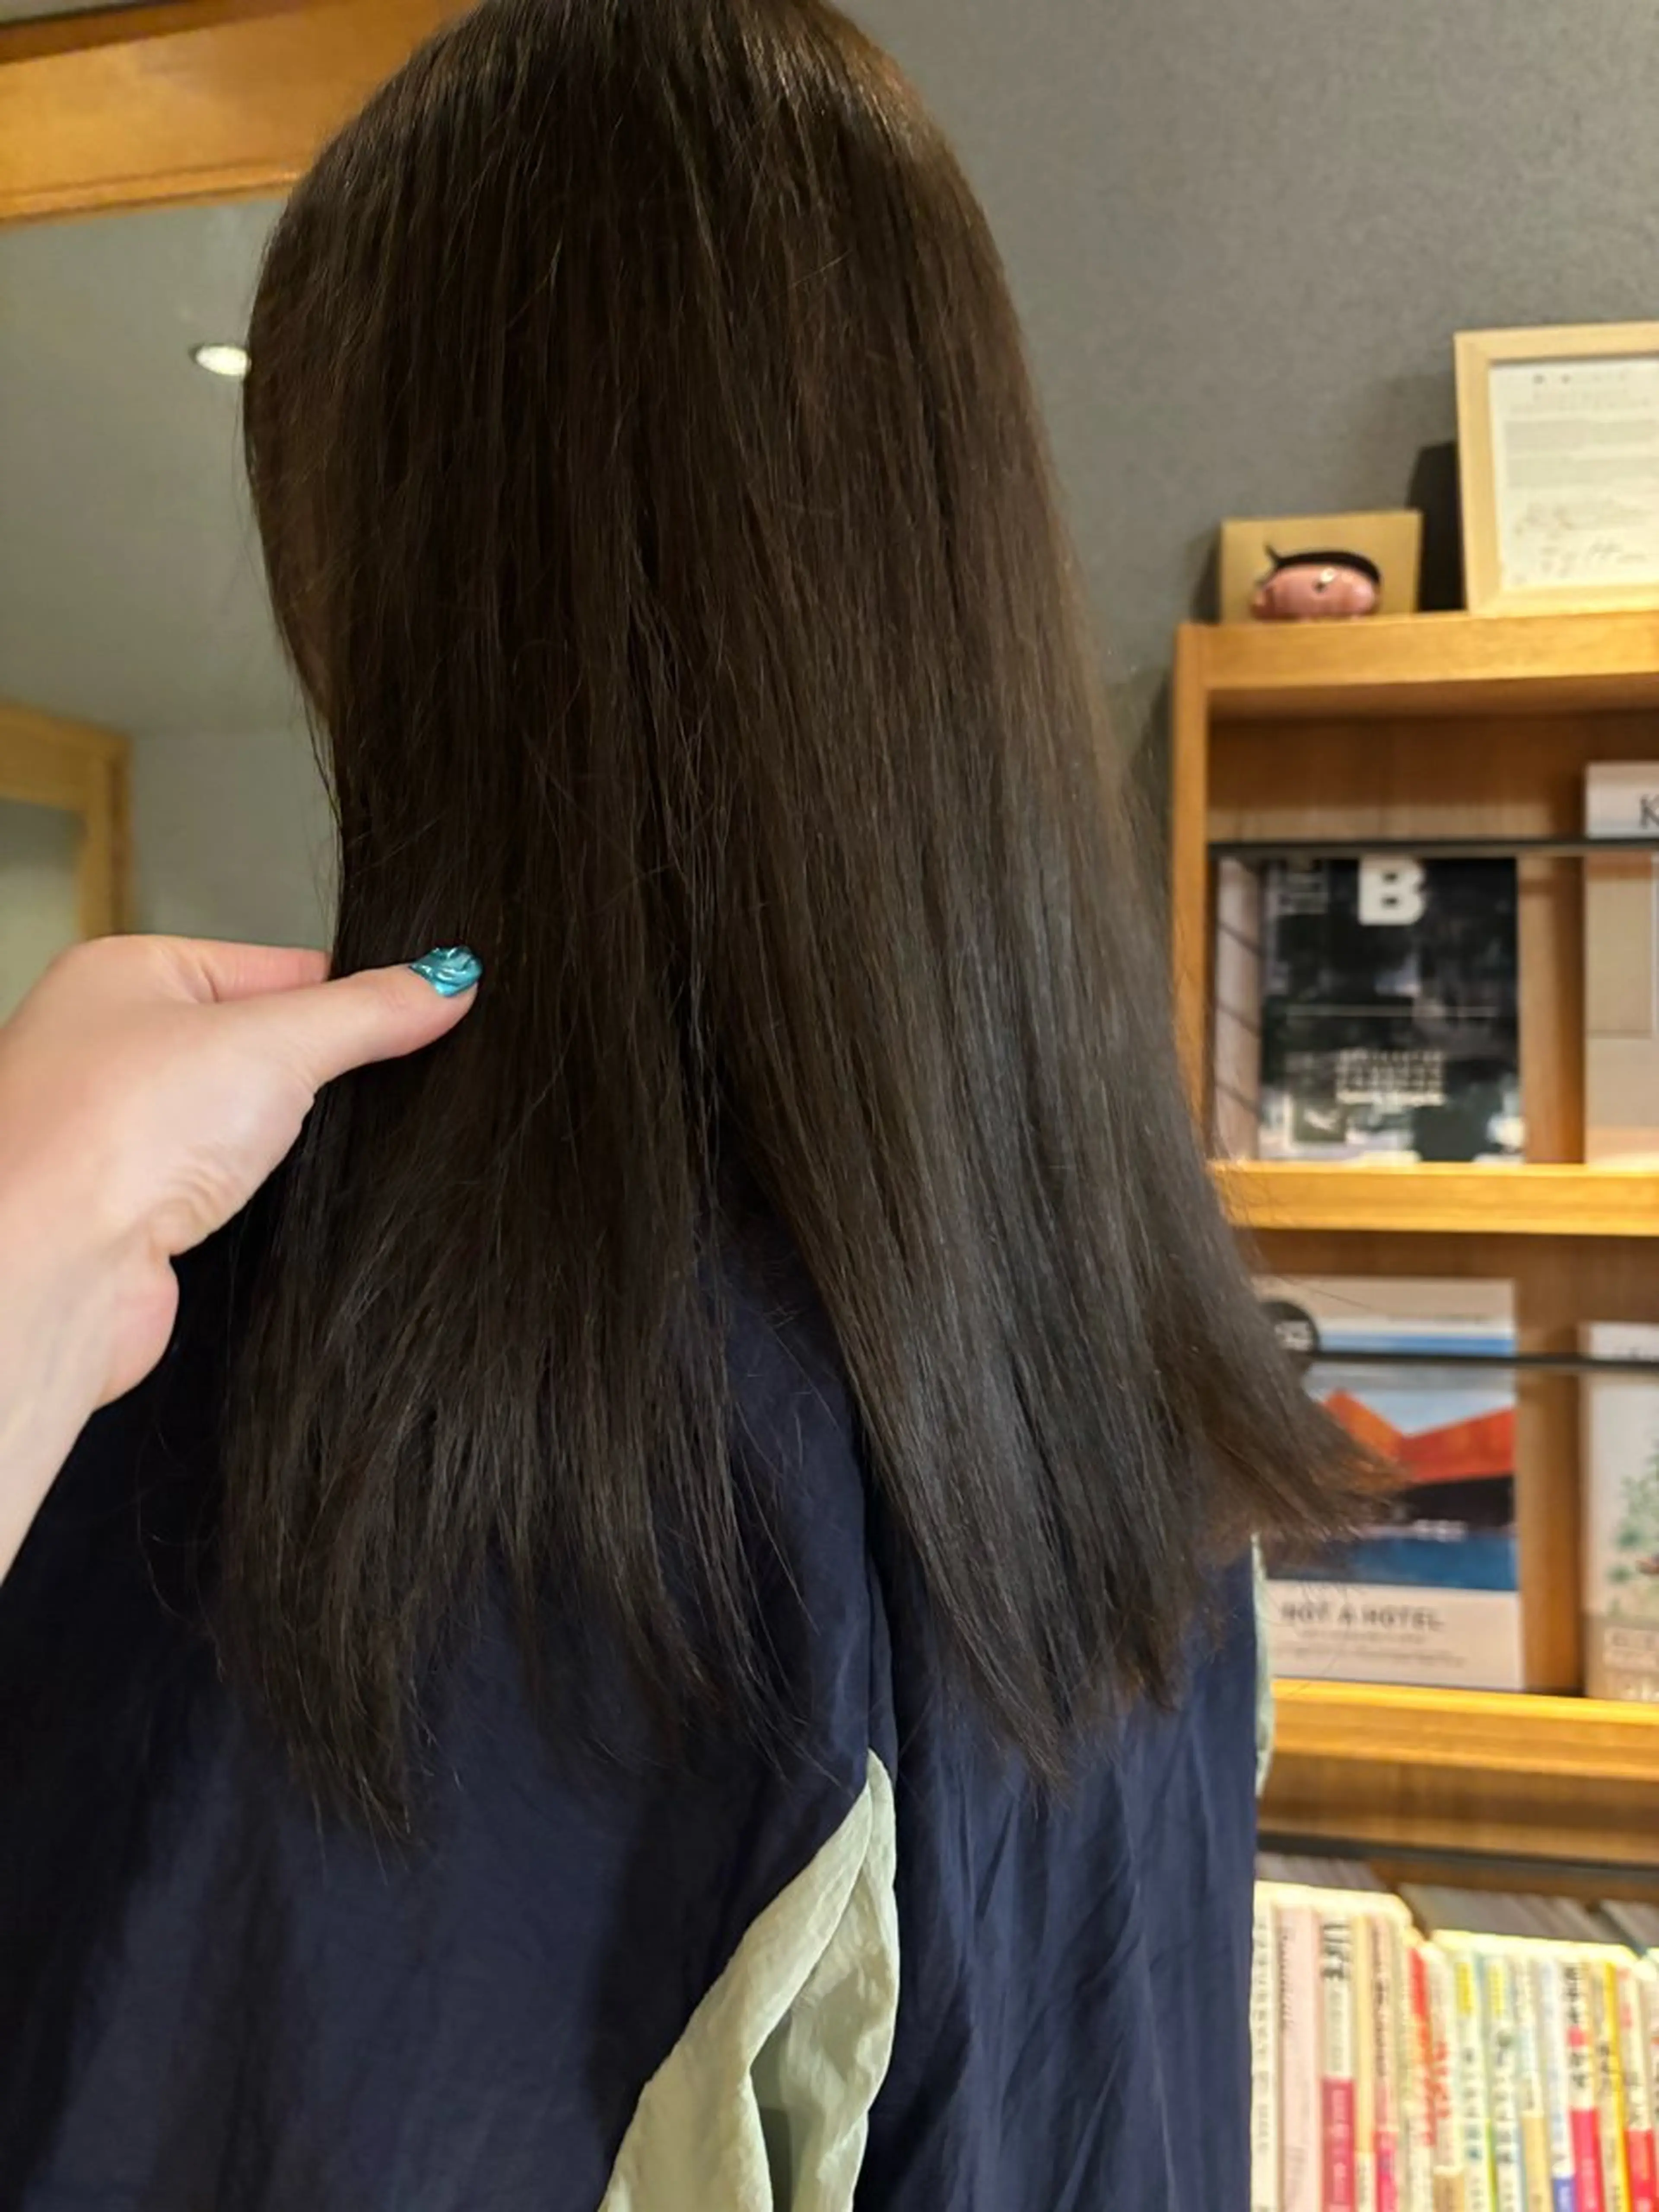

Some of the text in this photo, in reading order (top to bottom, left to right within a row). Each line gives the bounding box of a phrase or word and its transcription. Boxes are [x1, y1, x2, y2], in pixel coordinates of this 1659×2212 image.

[1358, 855, 1427, 926] B
[1281, 1601, 1444, 1630] NOT A HOTEL
